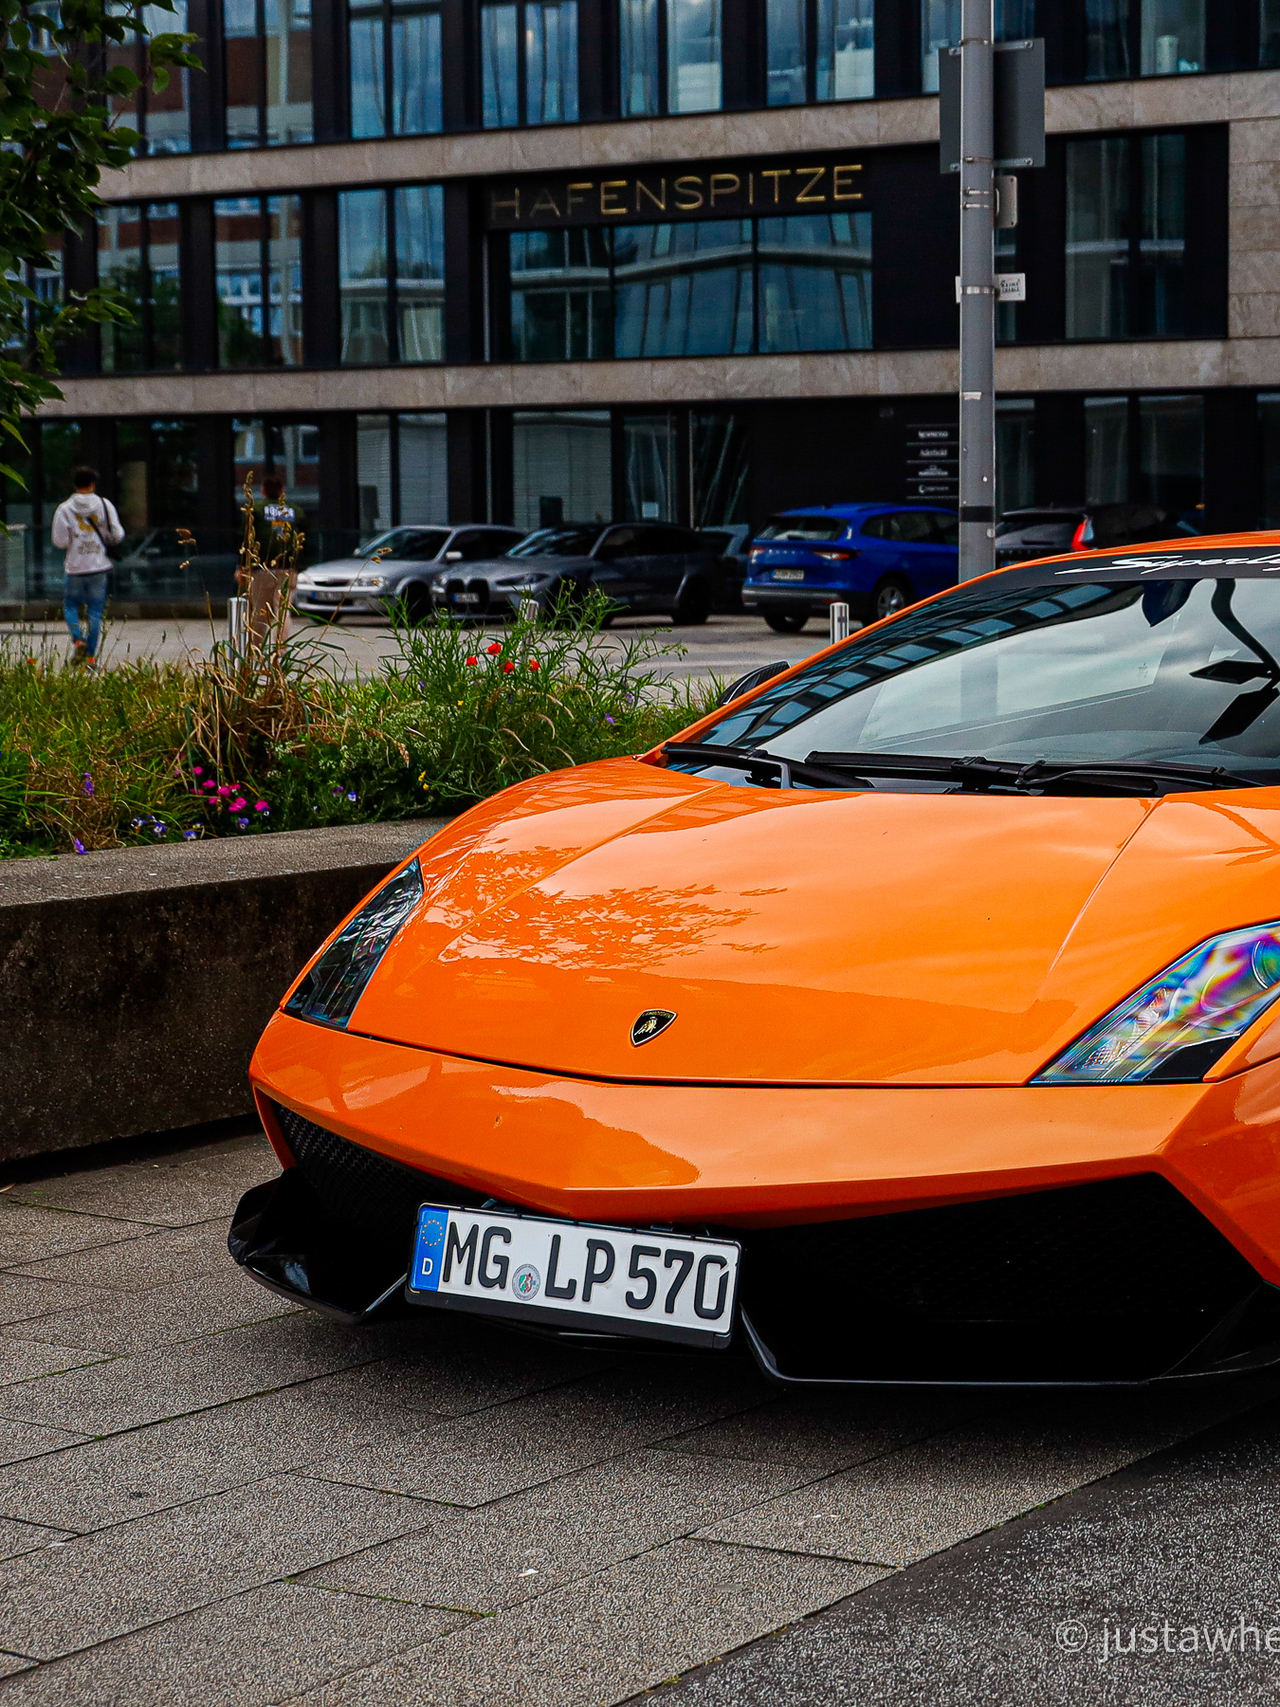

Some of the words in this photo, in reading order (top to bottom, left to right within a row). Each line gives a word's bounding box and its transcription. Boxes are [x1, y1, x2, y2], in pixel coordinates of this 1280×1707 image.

[489, 163, 863, 220] HAFENSPITZE
[421, 1257, 434, 1276] D
[442, 1221, 512, 1289] MG
[545, 1234, 616, 1302] LP
[625, 1244, 730, 1319] 570
